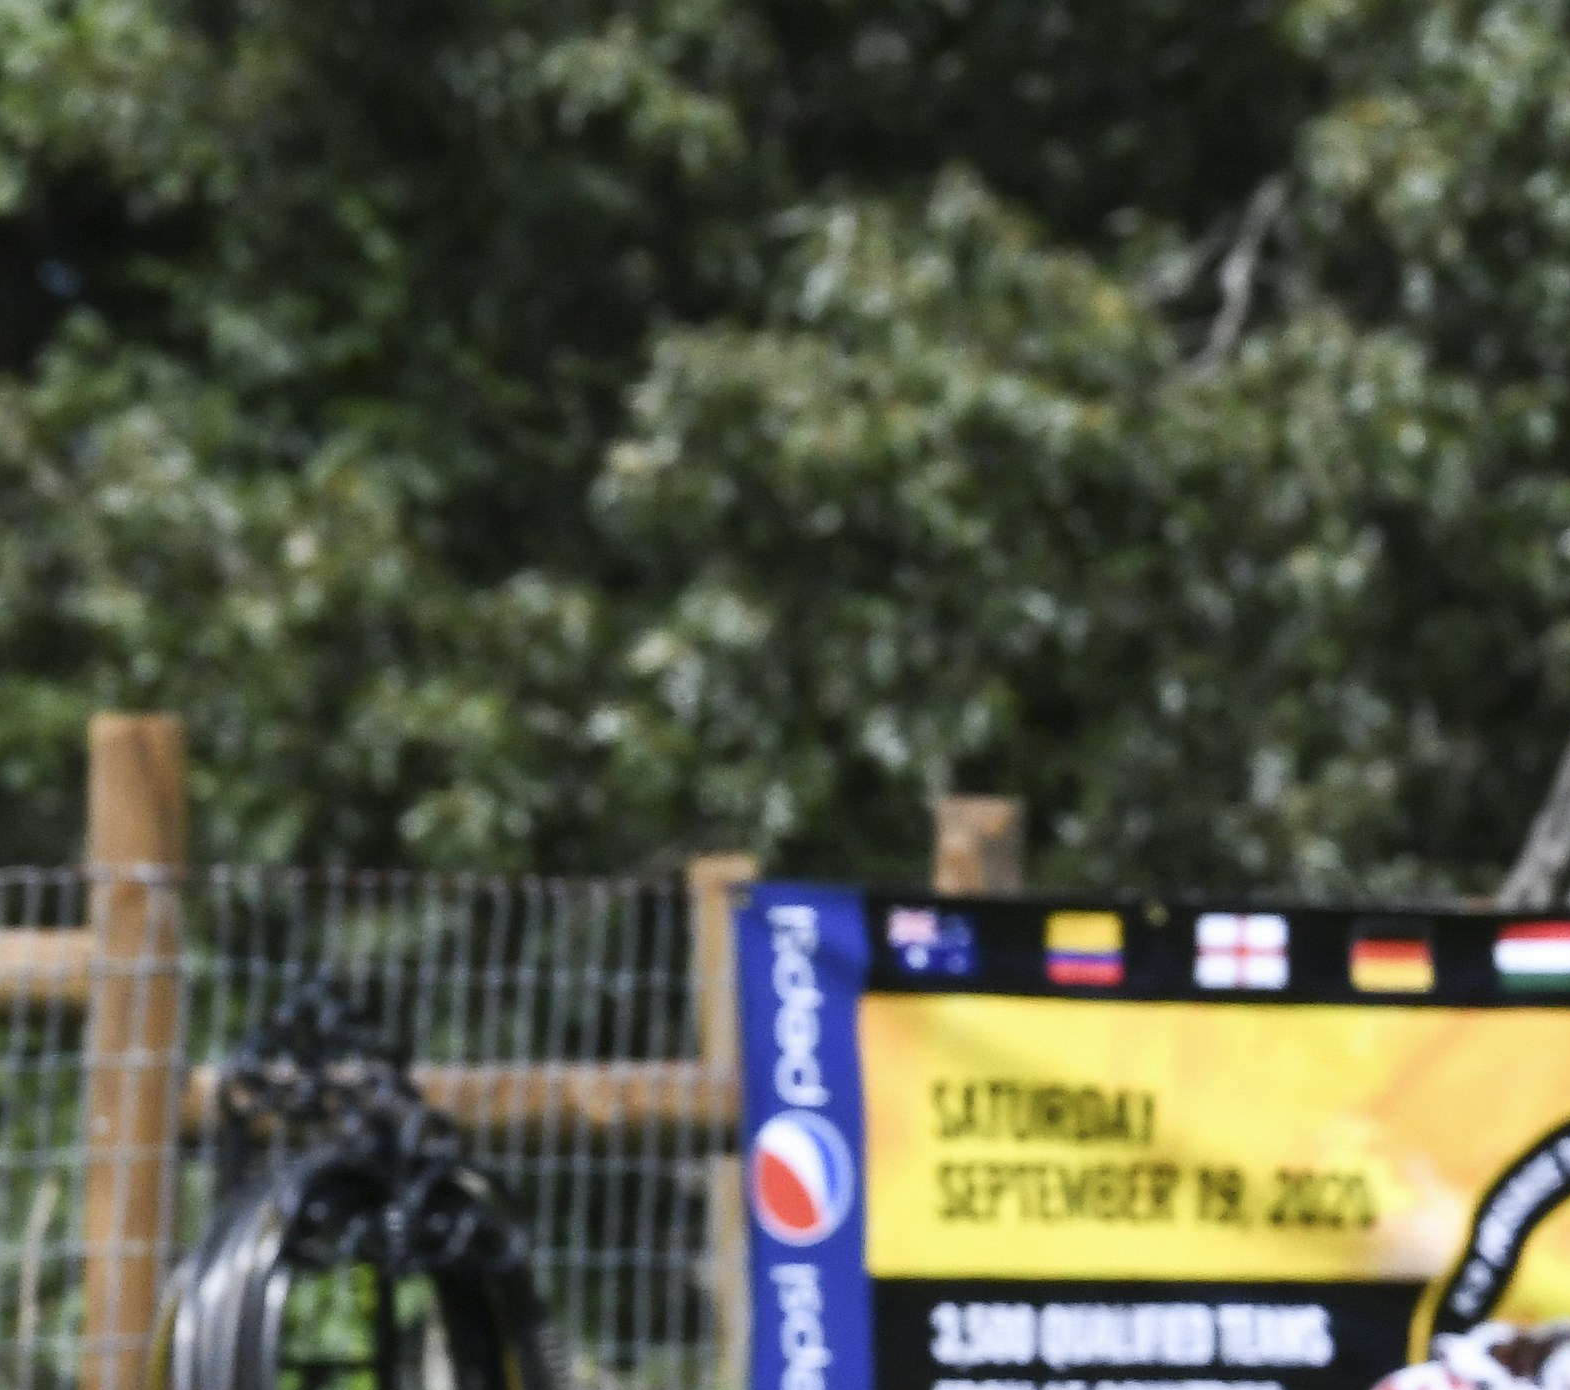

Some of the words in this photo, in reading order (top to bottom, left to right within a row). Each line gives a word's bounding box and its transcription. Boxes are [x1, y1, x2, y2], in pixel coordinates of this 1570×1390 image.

[768, 903, 829, 1107] pepsi
[931, 1078, 1155, 1146] SATURDAY
[937, 1161, 1181, 1225] SEPTEMBER
[1266, 1166, 1380, 1230] 2020
[1218, 1303, 1333, 1368] TEAMS
